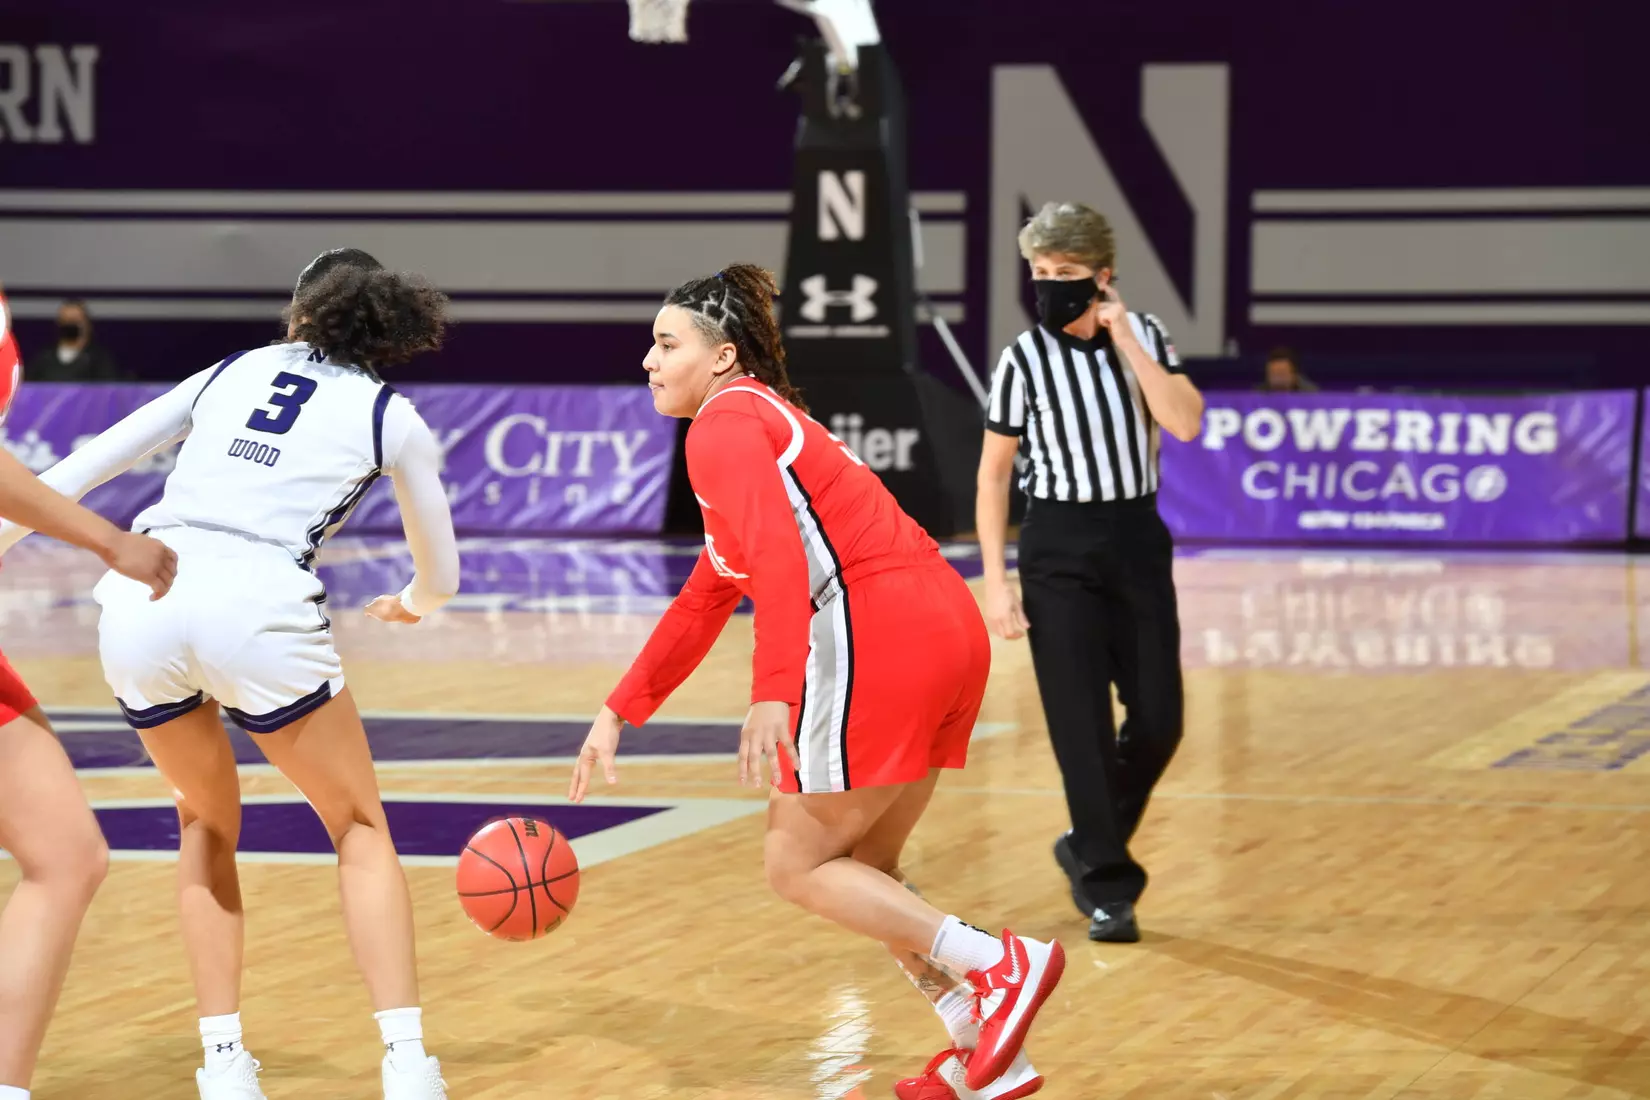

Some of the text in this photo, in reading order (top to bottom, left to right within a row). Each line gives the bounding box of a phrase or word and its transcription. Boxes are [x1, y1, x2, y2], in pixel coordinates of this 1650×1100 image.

[818, 170, 865, 241] N
[989, 64, 1229, 372] N
[245, 371, 318, 435] 3
[1202, 408, 1558, 454] POWERING
[228, 438, 281, 468] WOOD
